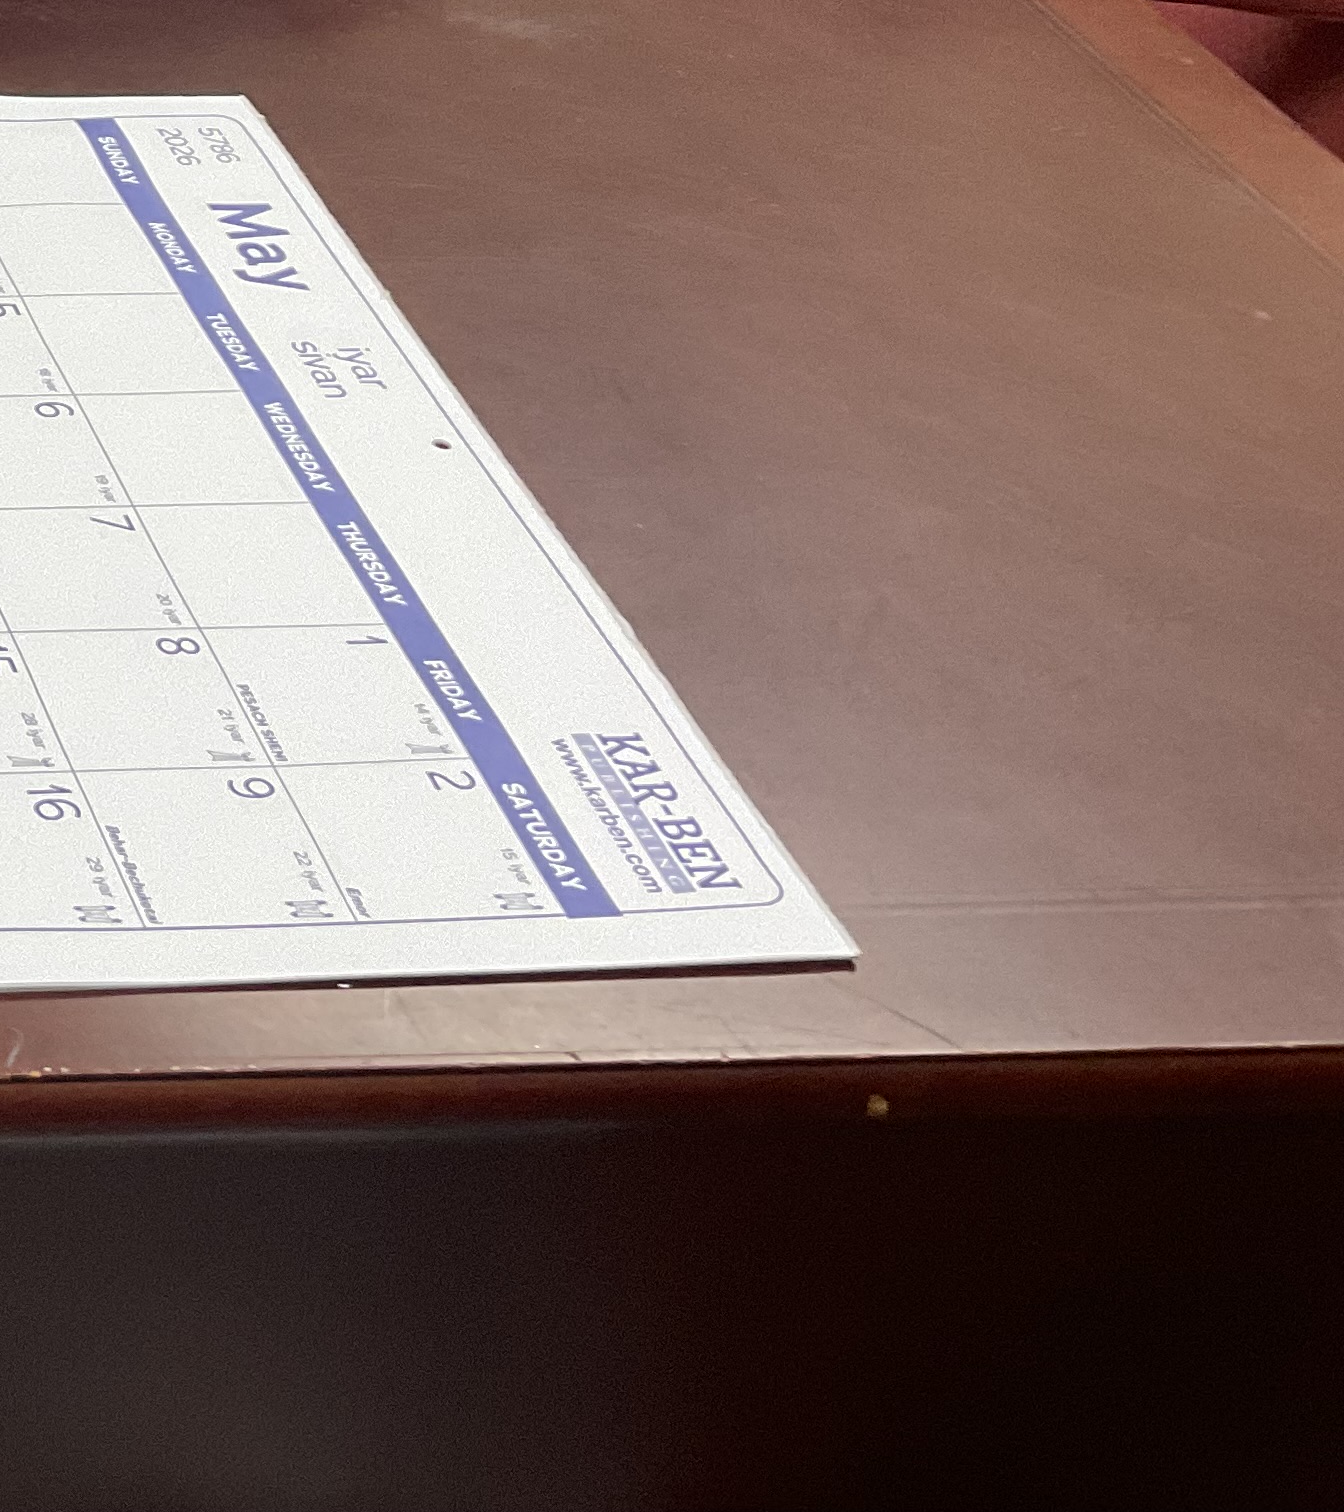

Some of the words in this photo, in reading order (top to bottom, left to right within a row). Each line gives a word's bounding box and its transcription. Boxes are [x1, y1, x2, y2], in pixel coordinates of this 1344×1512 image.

[155, 127, 201, 166] 2026
[198, 126, 241, 164] 5786
[206, 202, 311, 292] May
[291, 341, 347, 399] sivan
[330, 347, 388, 390] iyar
[34, 401, 75, 418] 6
[89, 514, 136, 532] 7
[98, 136, 140, 185] SUNDAY
[148, 222, 197, 274] MONDAY
[206, 313, 261, 372] TUESDAY
[263, 400, 335, 493] WEDNESDAY
[337, 520, 408, 606] THURSDAY
[423, 659, 482, 721] FRIDAY
[501, 782, 588, 890] SATURDAY
[156, 637, 200, 655] 8
[346, 635, 388, 645] 1
[227, 777, 275, 799] 9
[425, 770, 476, 791] 2
[27, 784, 81, 820] 16
[551, 737, 663, 894] www.karben.com
[581, 743, 686, 888] PUBLISHING
[596, 732, 743, 889] KAR-BEN
[93, 877, 113, 898] iyar
[301, 870, 324, 892] iyar
